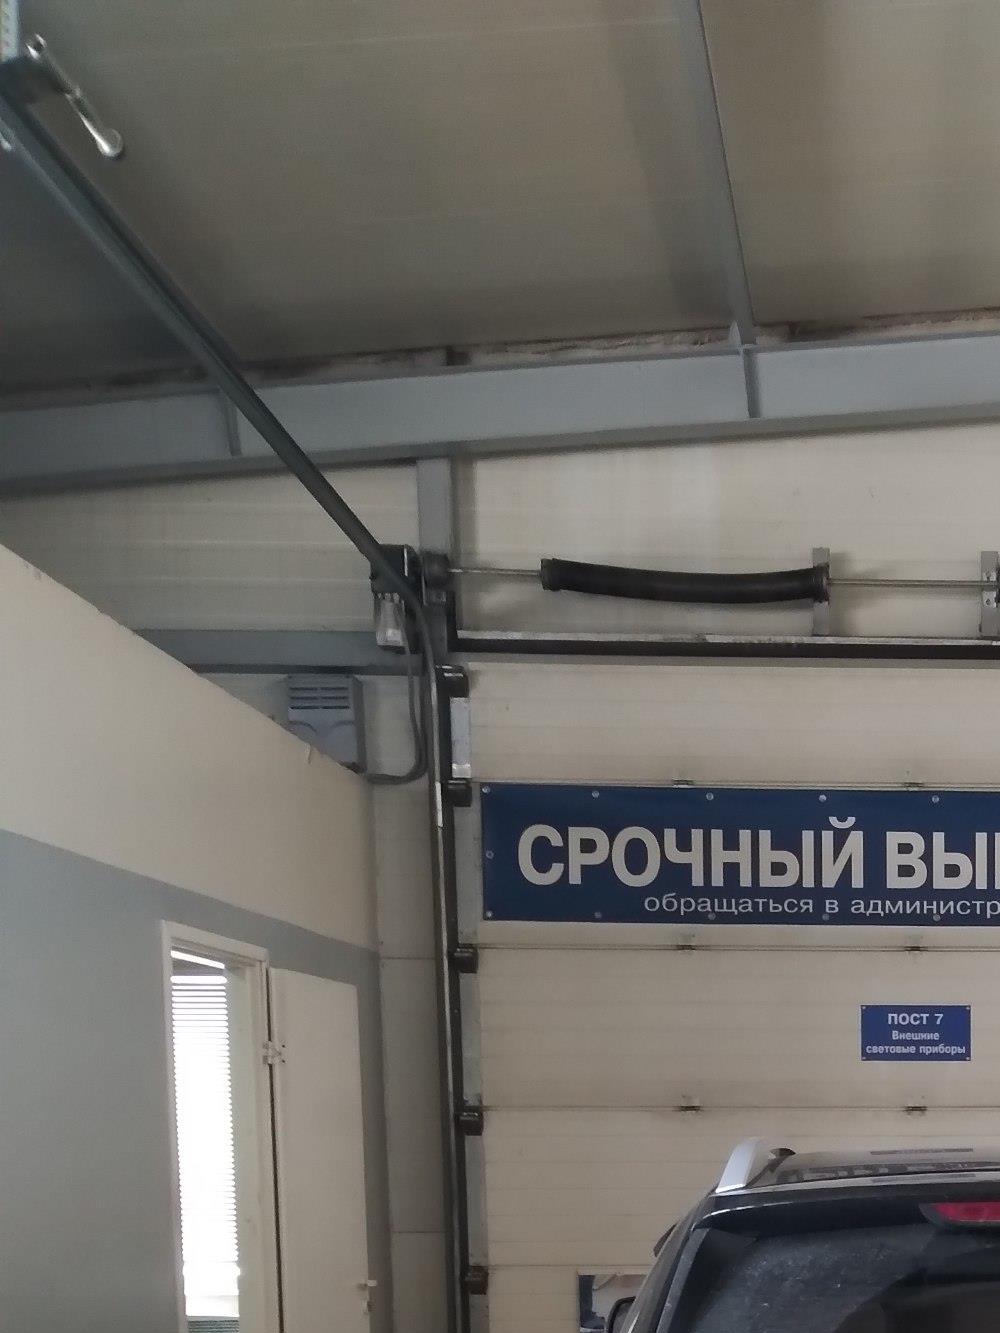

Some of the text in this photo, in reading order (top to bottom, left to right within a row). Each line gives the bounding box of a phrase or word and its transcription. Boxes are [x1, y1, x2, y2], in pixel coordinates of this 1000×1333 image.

[518, 816, 864, 888] СРОЧНЫЙ
[644, 893, 814, 916] обращаться
[825, 900, 840, 913] в
[887, 1013, 944, 1025] ПОСТ 7
[891, 1030, 941, 1041] Внешние
[865, 1043, 966, 1055] световые приборы
